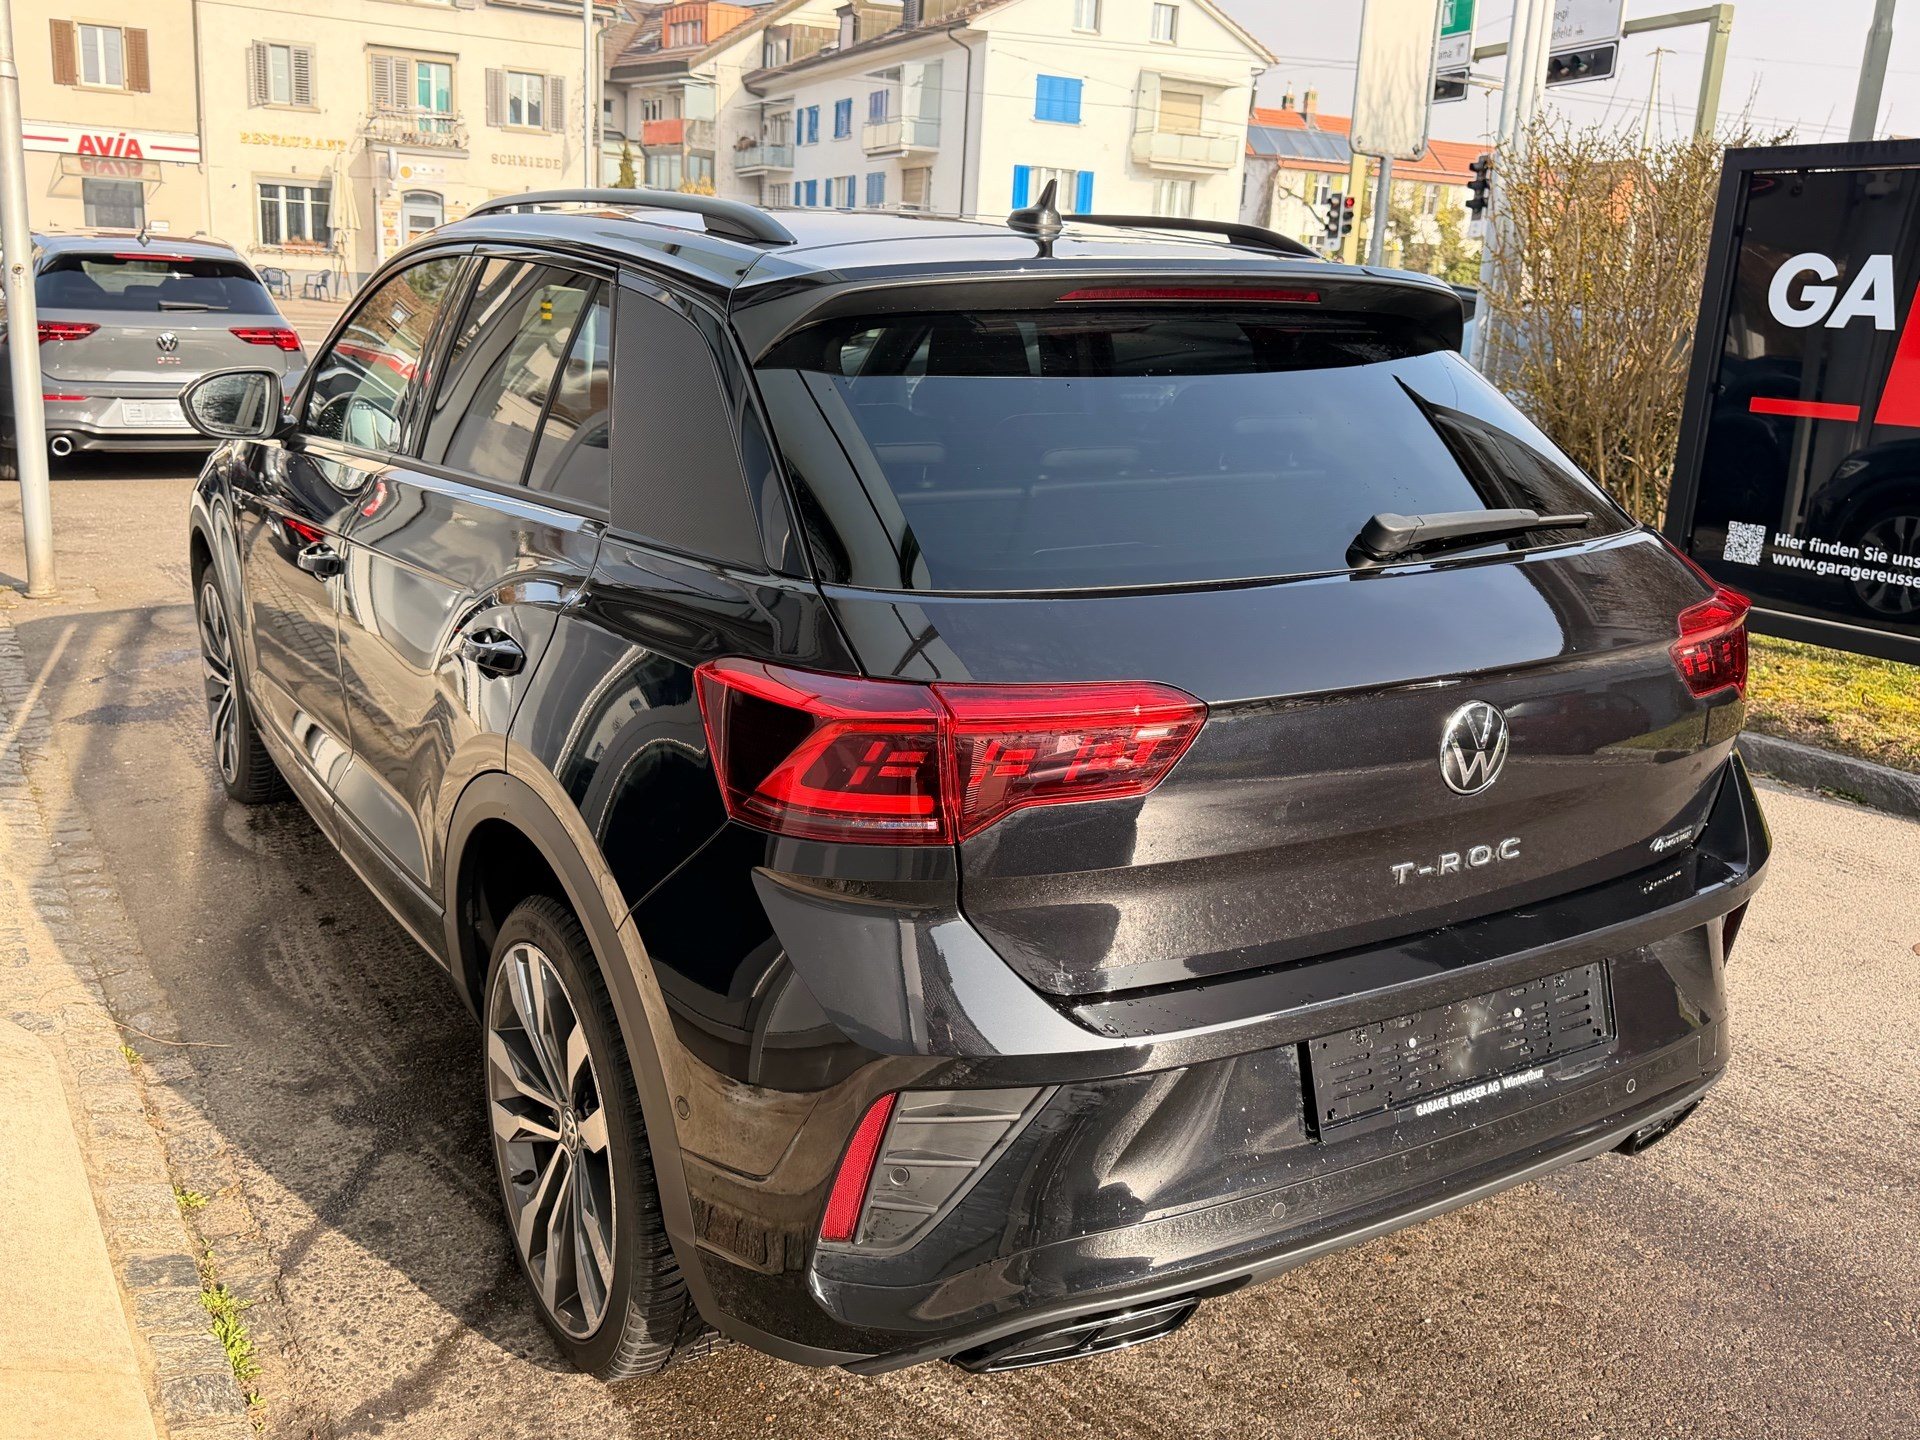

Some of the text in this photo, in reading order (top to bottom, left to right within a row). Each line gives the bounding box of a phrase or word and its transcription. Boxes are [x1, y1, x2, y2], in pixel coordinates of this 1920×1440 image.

[240, 132, 347, 152] RESTAURANT
[490, 153, 562, 170] SCHMIEDE
[1767, 252, 1897, 331] GA
[1774, 532, 1806, 550] Hier
[1809, 538, 1859, 559] finden
[1863, 546, 1889, 563] Sie
[1390, 837, 1521, 885] T-ROC
[1416, 1069, 1544, 1116] GARAGE REUSSER AG Winterthur
